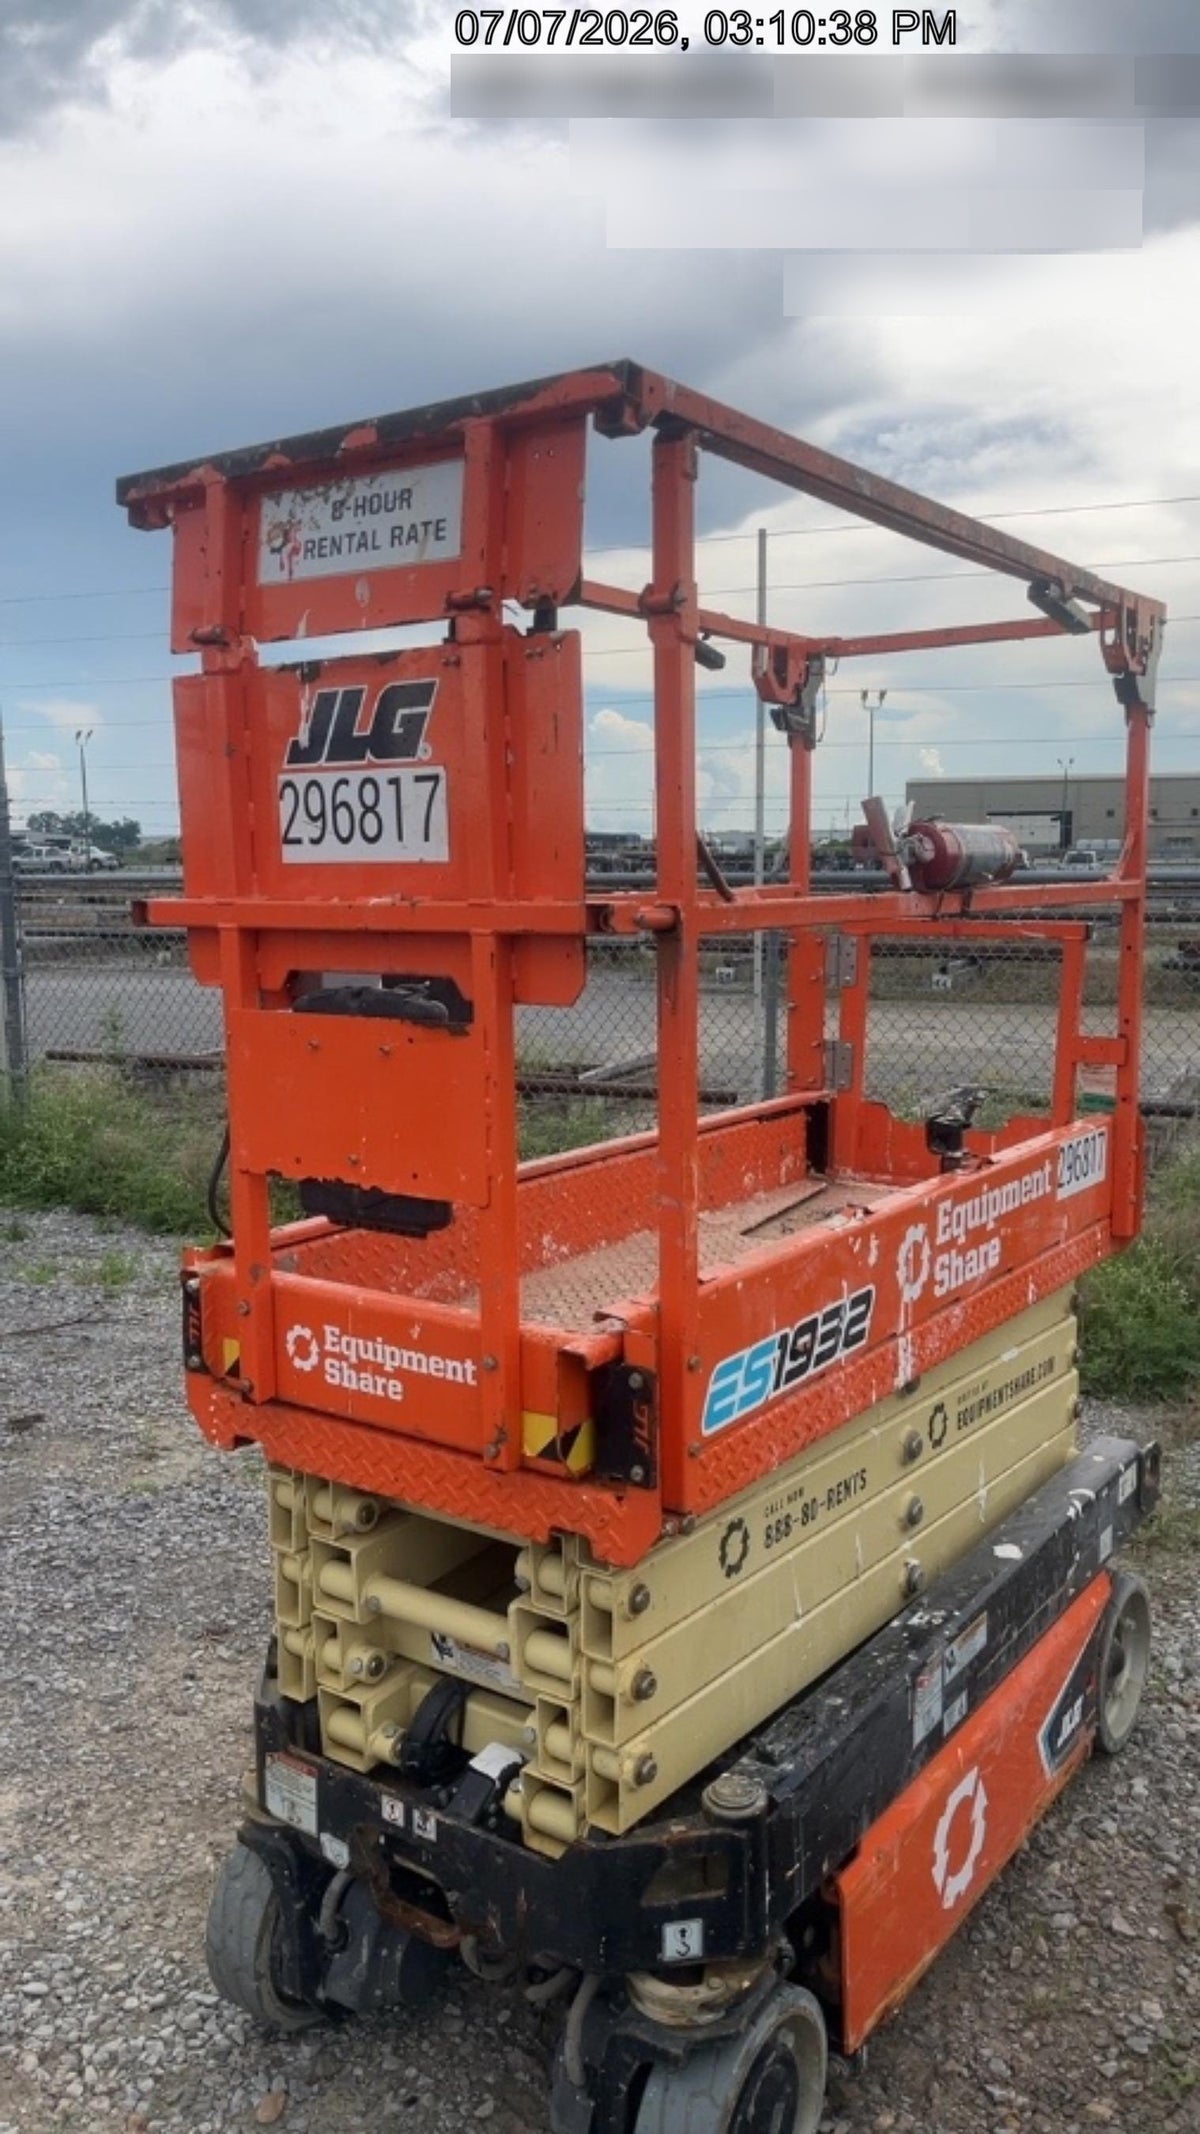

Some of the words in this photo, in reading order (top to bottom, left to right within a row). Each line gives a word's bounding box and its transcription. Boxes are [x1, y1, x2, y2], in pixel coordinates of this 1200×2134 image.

[303, 530, 381, 560] RENTAL
[391, 518, 447, 549] RATE
[283, 678, 439, 768] JLG
[279, 773, 440, 845] 296817
[936, 1159, 1052, 1246] Equipment
[933, 1236, 1001, 1298] Share
[323, 1324, 478, 1387] Equipment
[323, 1358, 404, 1402] Share
[702, 1284, 876, 1437] ES1932
